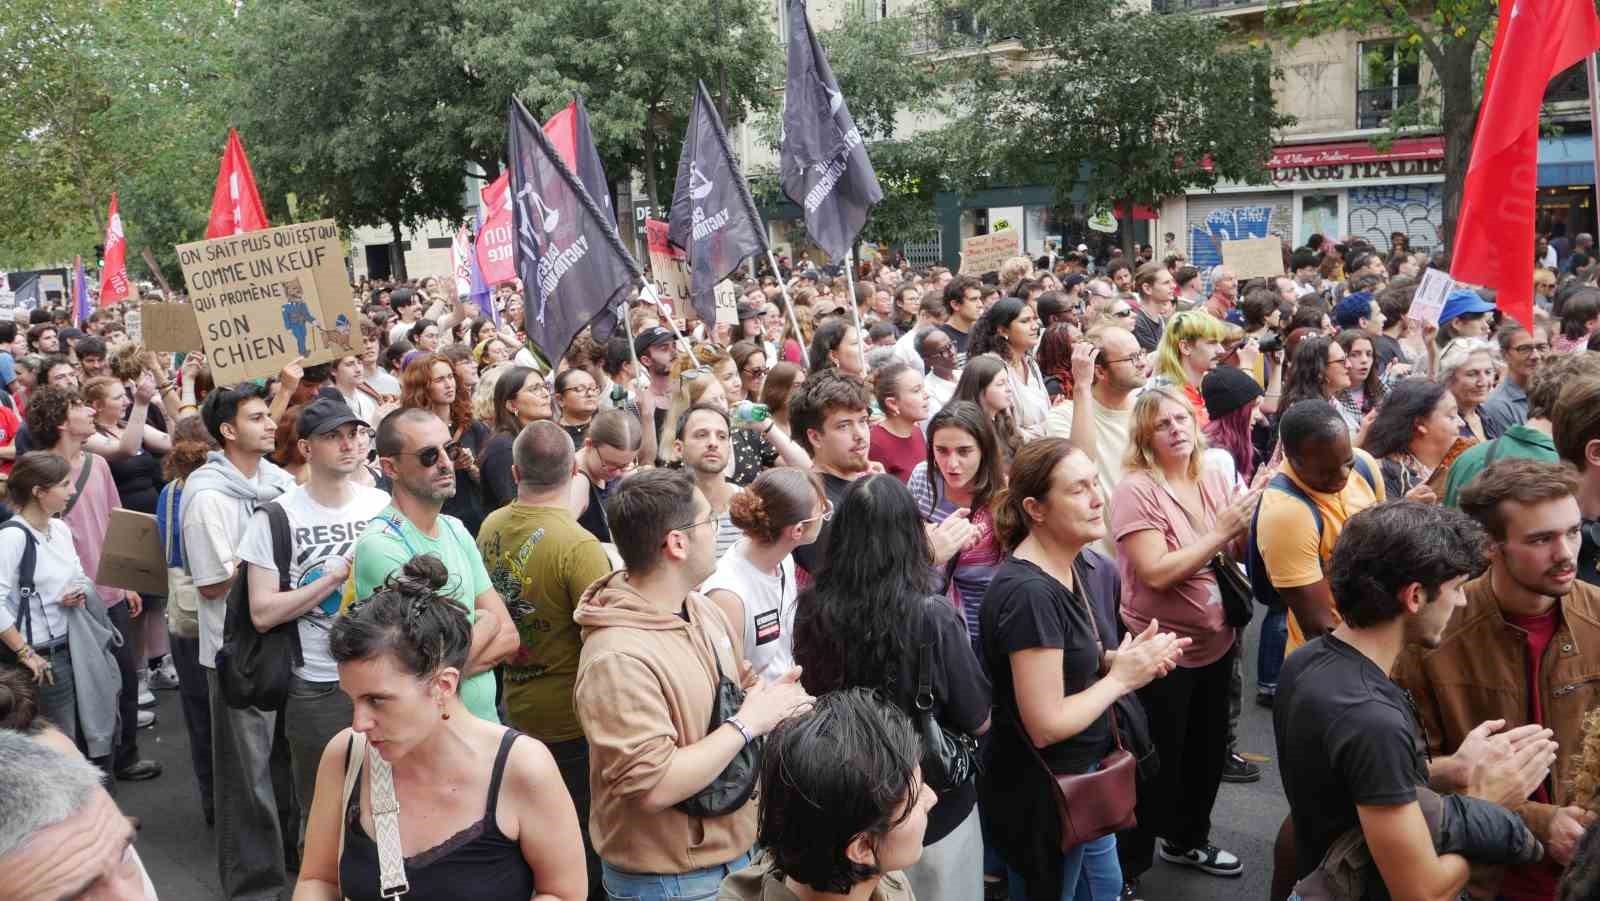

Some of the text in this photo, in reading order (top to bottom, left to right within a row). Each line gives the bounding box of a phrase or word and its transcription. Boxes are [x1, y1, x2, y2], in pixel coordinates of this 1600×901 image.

[1348, 159, 1446, 178] ITALIE
[181, 249, 202, 265] ON
[241, 235, 271, 253] PLUS
[192, 246, 327, 290] COMME UN KEUF
[208, 314, 250, 341] SON
[295, 520, 369, 545] RESIS
